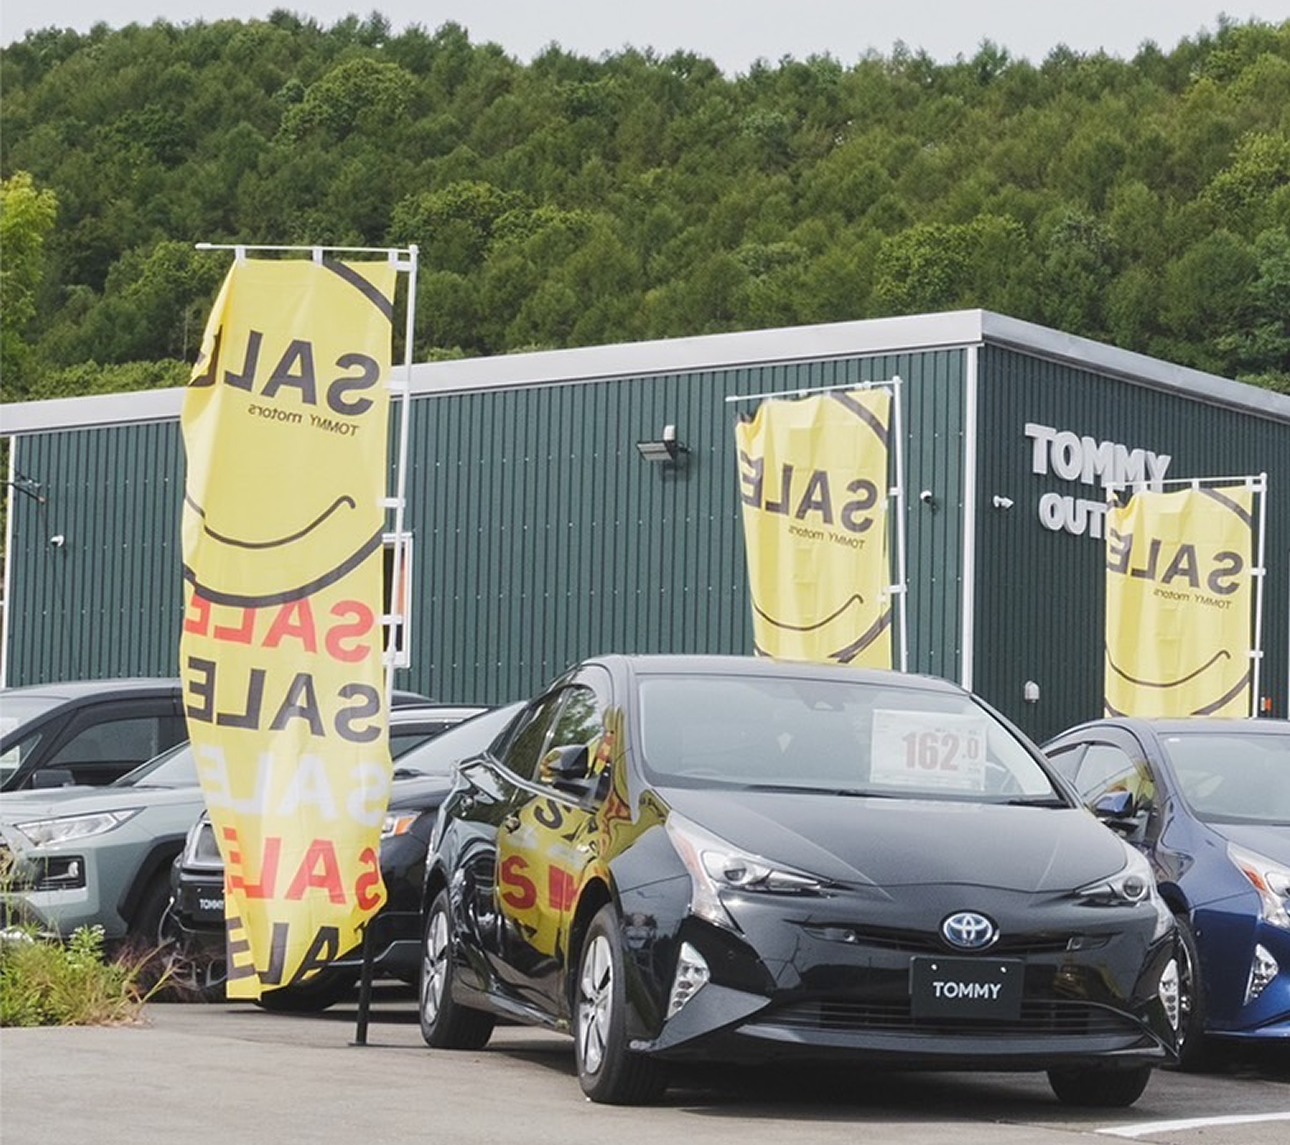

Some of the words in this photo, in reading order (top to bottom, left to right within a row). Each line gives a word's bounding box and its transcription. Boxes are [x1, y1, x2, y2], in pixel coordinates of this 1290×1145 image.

[1025, 423, 1171, 492] TOMMY
[1039, 493, 1107, 540] OUT
[933, 982, 1001, 999] TOMMY
